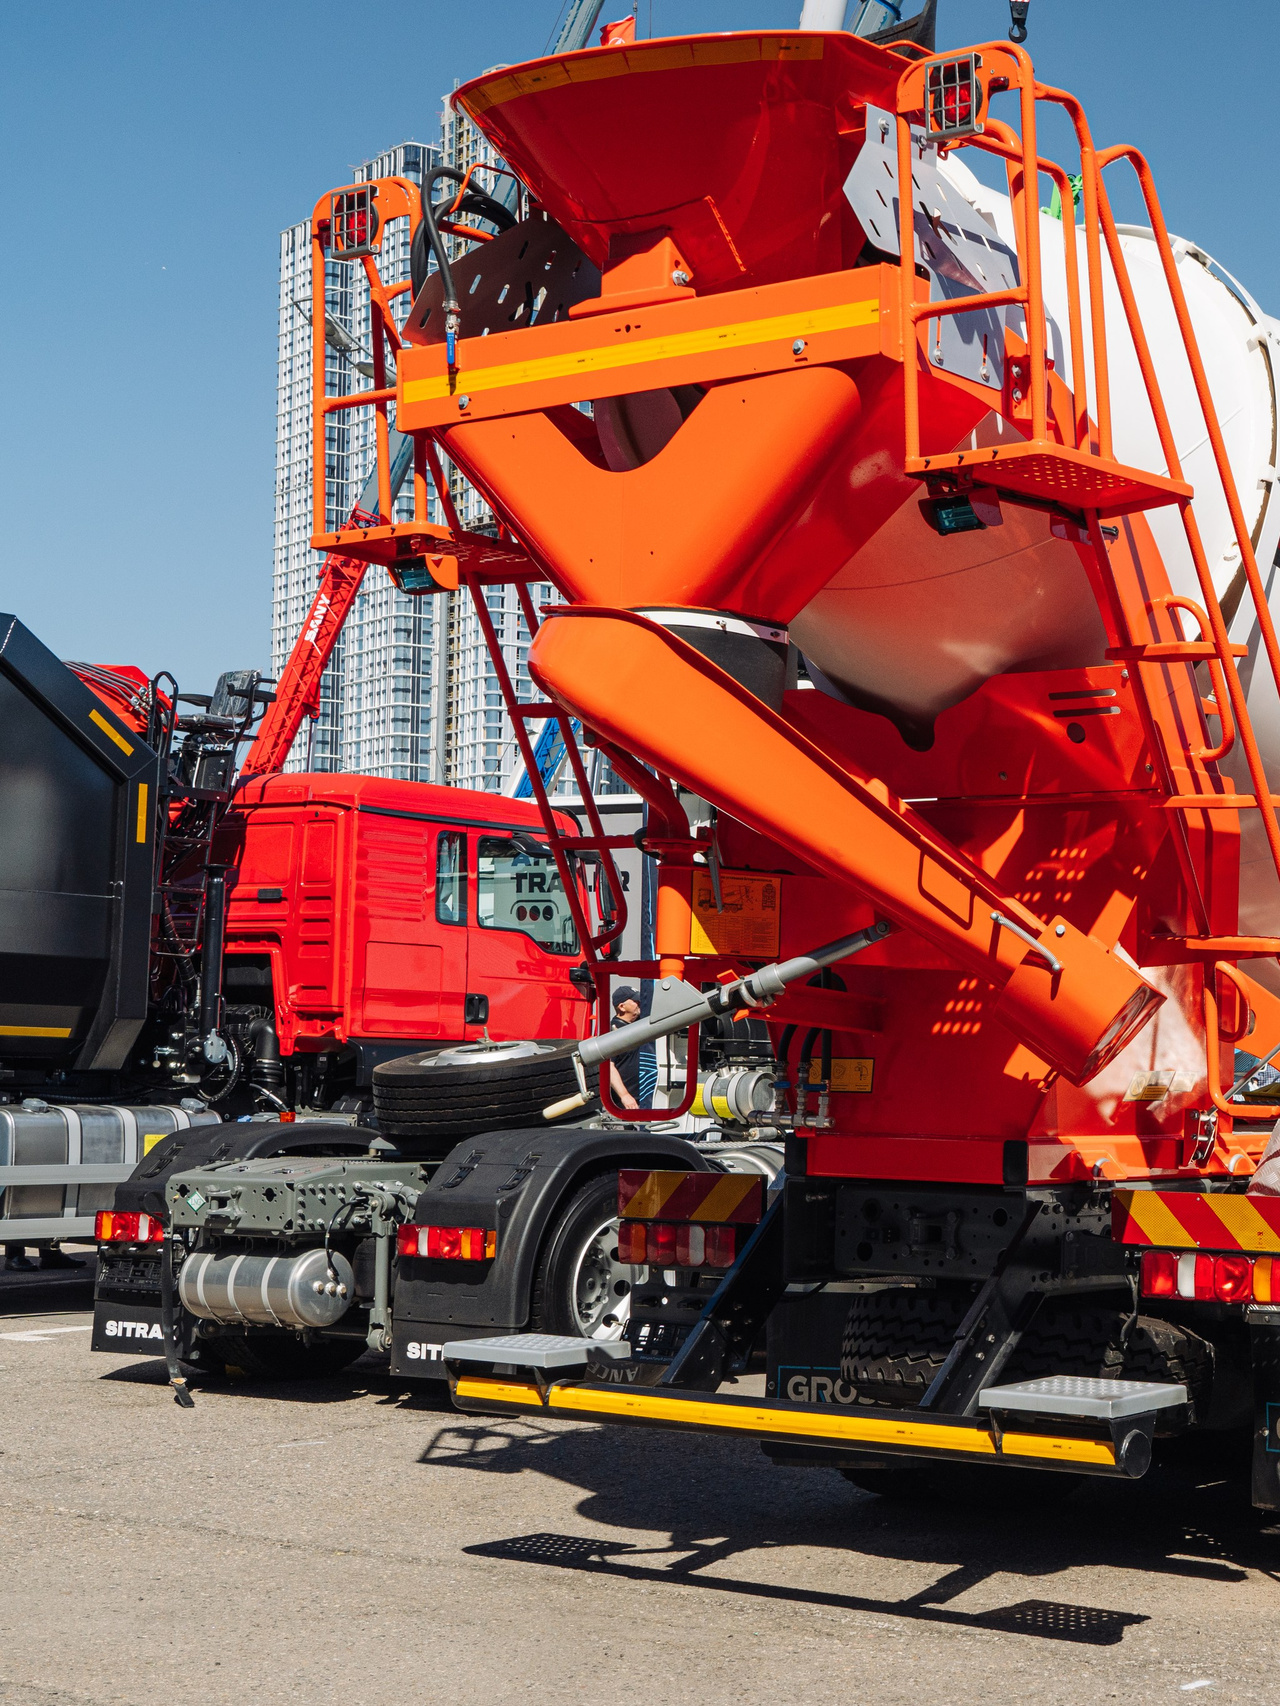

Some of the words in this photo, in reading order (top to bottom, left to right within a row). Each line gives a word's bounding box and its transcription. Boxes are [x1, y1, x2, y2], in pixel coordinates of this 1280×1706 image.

[304, 593, 331, 642] SANY
[106, 1321, 177, 1341] SITRA
[407, 1343, 444, 1361] SIT
[787, 1375, 892, 1405] GRO
